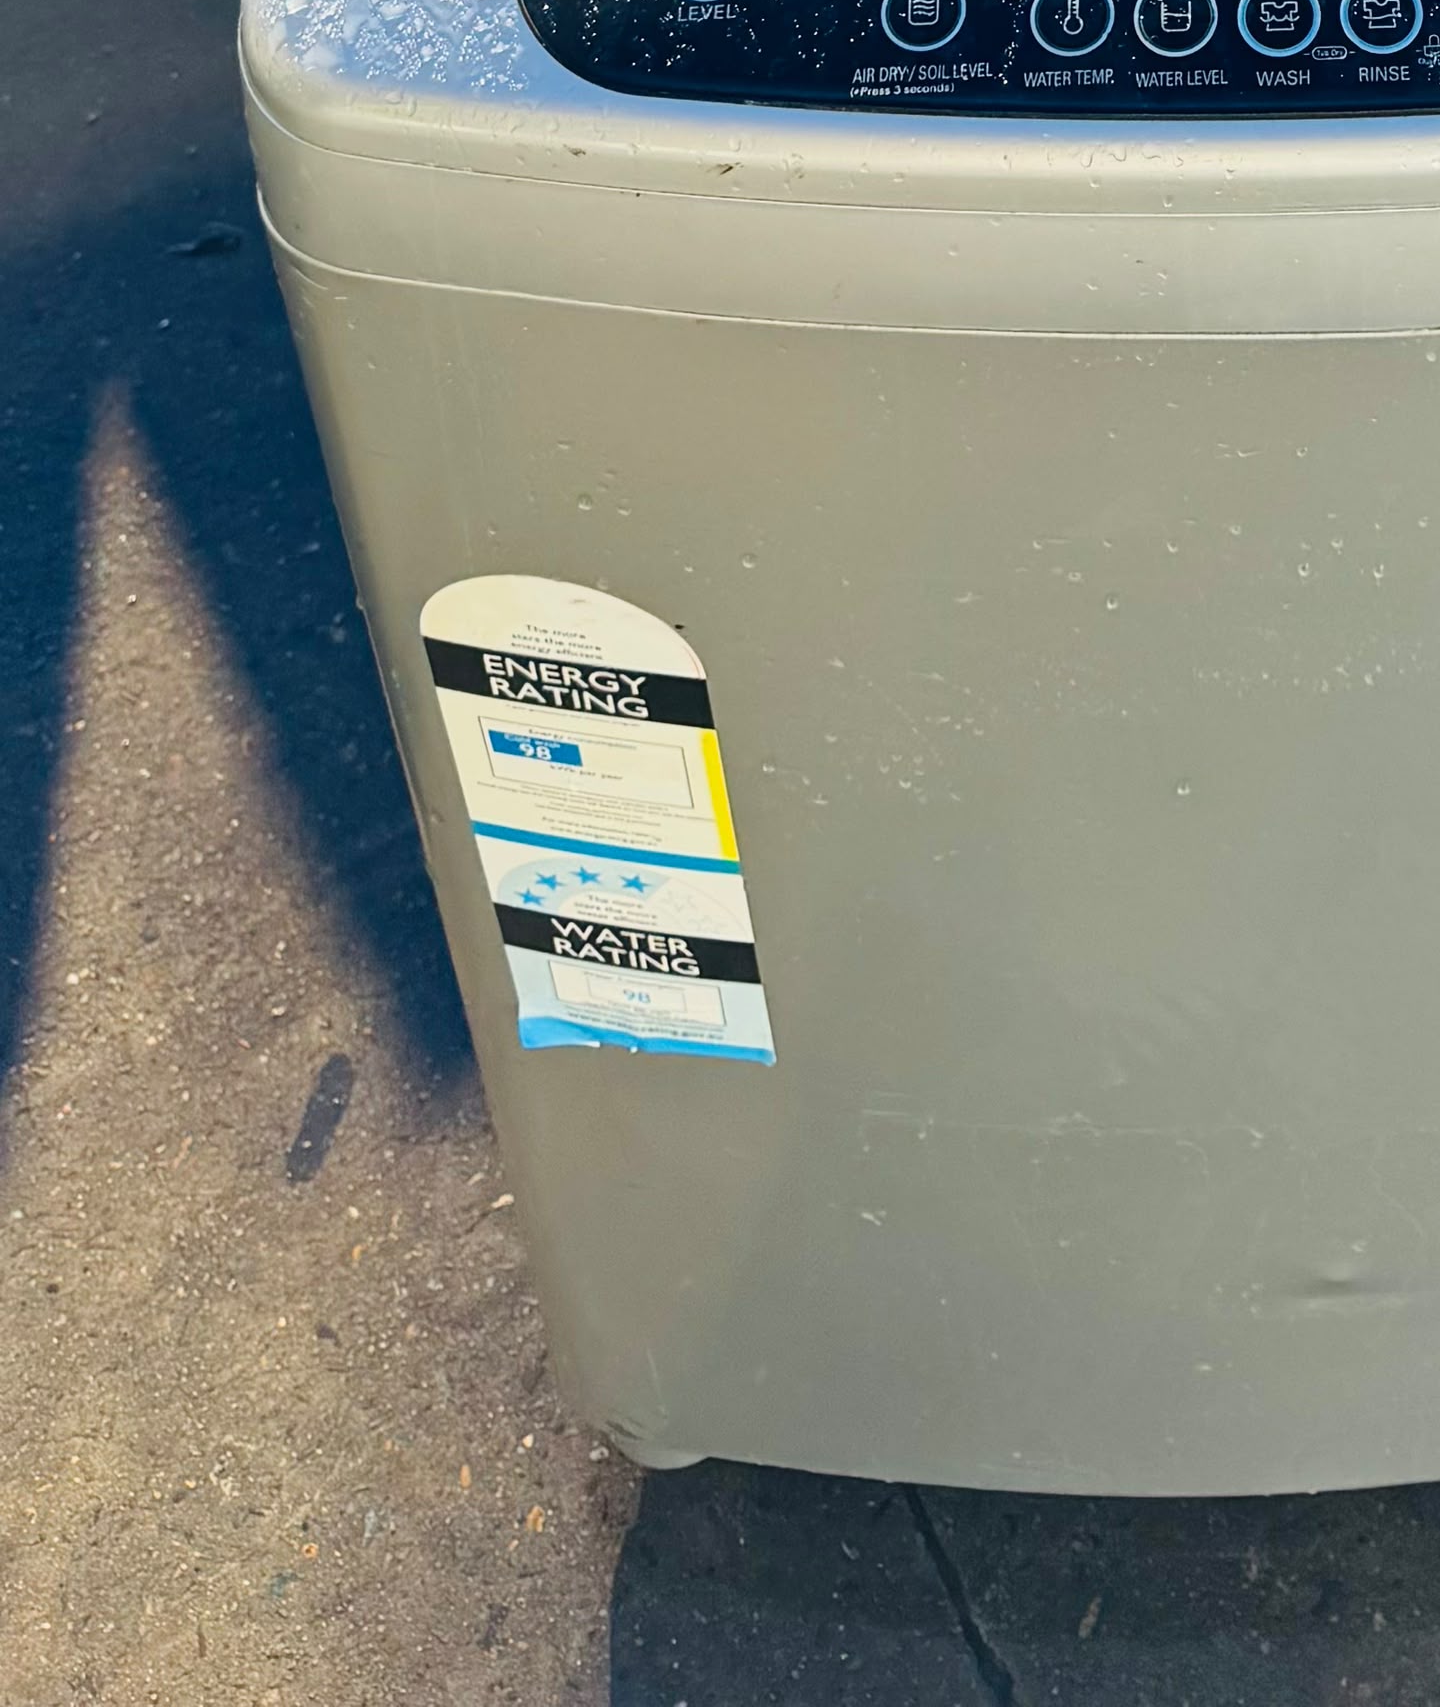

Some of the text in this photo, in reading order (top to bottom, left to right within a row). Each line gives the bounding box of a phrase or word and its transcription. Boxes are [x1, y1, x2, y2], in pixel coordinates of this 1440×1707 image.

[677, 4, 737, 22] LEVEL
[852, 68, 875, 83] AIR
[918, 64, 950, 80] SOIL
[953, 62, 993, 78] LEVEL
[1024, 71, 1072, 87] WATER
[1136, 69, 1228, 87] WATER LEVEL
[1256, 70, 1311, 86] WASH
[1358, 66, 1411, 83] RINSE
[893, 85, 901, 95] 3
[483, 653, 647, 696] ENERGY
[489, 676, 649, 719] RATING
[519, 743, 552, 761] 98
[551, 918, 694, 958] WATER
[553, 937, 701, 977] RATING
